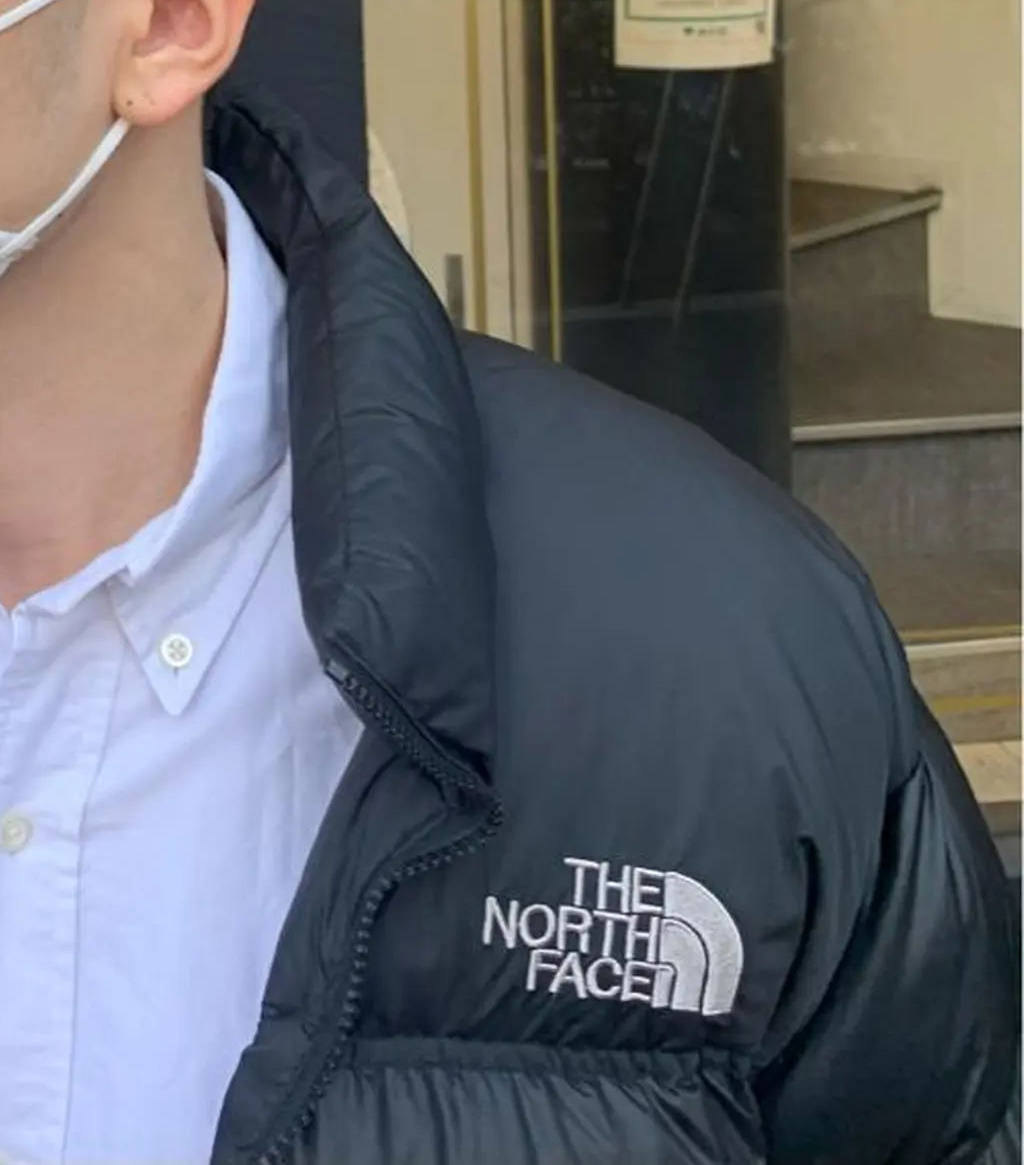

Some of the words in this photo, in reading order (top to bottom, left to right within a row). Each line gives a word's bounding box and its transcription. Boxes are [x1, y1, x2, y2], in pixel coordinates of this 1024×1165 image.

[564, 857, 664, 914] THE
[482, 896, 660, 962] NORTH
[526, 948, 652, 1001] FACE
